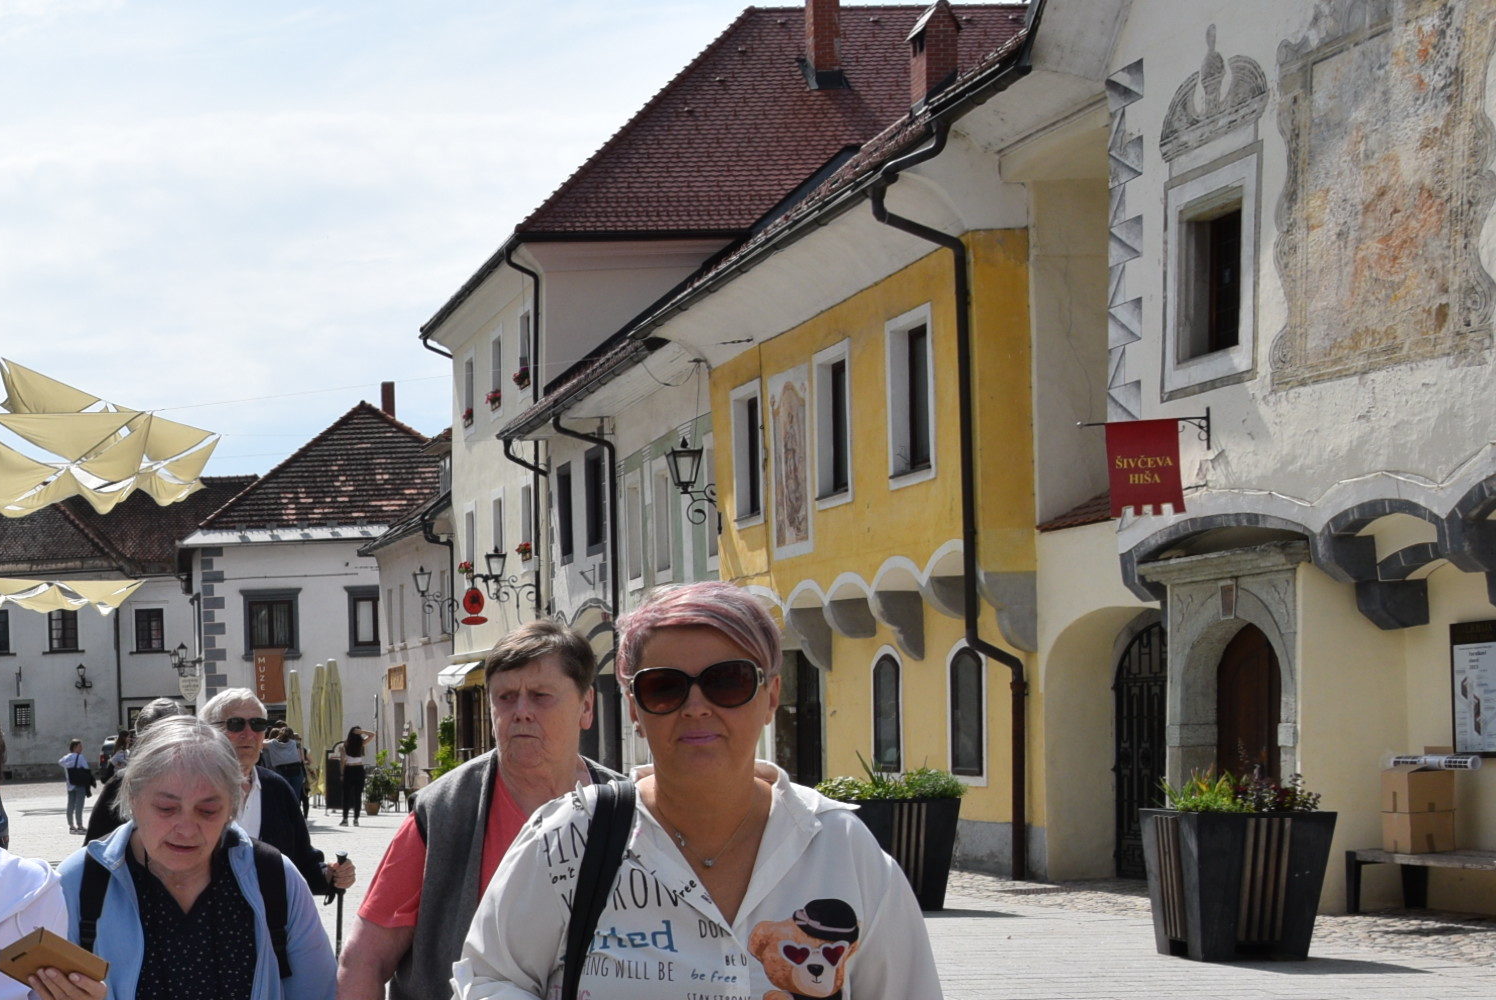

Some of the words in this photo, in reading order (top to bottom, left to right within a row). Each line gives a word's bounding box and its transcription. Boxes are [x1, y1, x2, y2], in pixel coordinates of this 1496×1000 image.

[1115, 455, 1173, 469] ŠIVČEVA
[1129, 470, 1162, 484] HIŠA
[257, 656, 266, 702] MUZEJ
[725, 955, 736, 967] BE
[615, 958, 650, 981] WILL
[658, 961, 675, 982] BE
[691, 968, 706, 981] be
[710, 971, 737, 983] free
